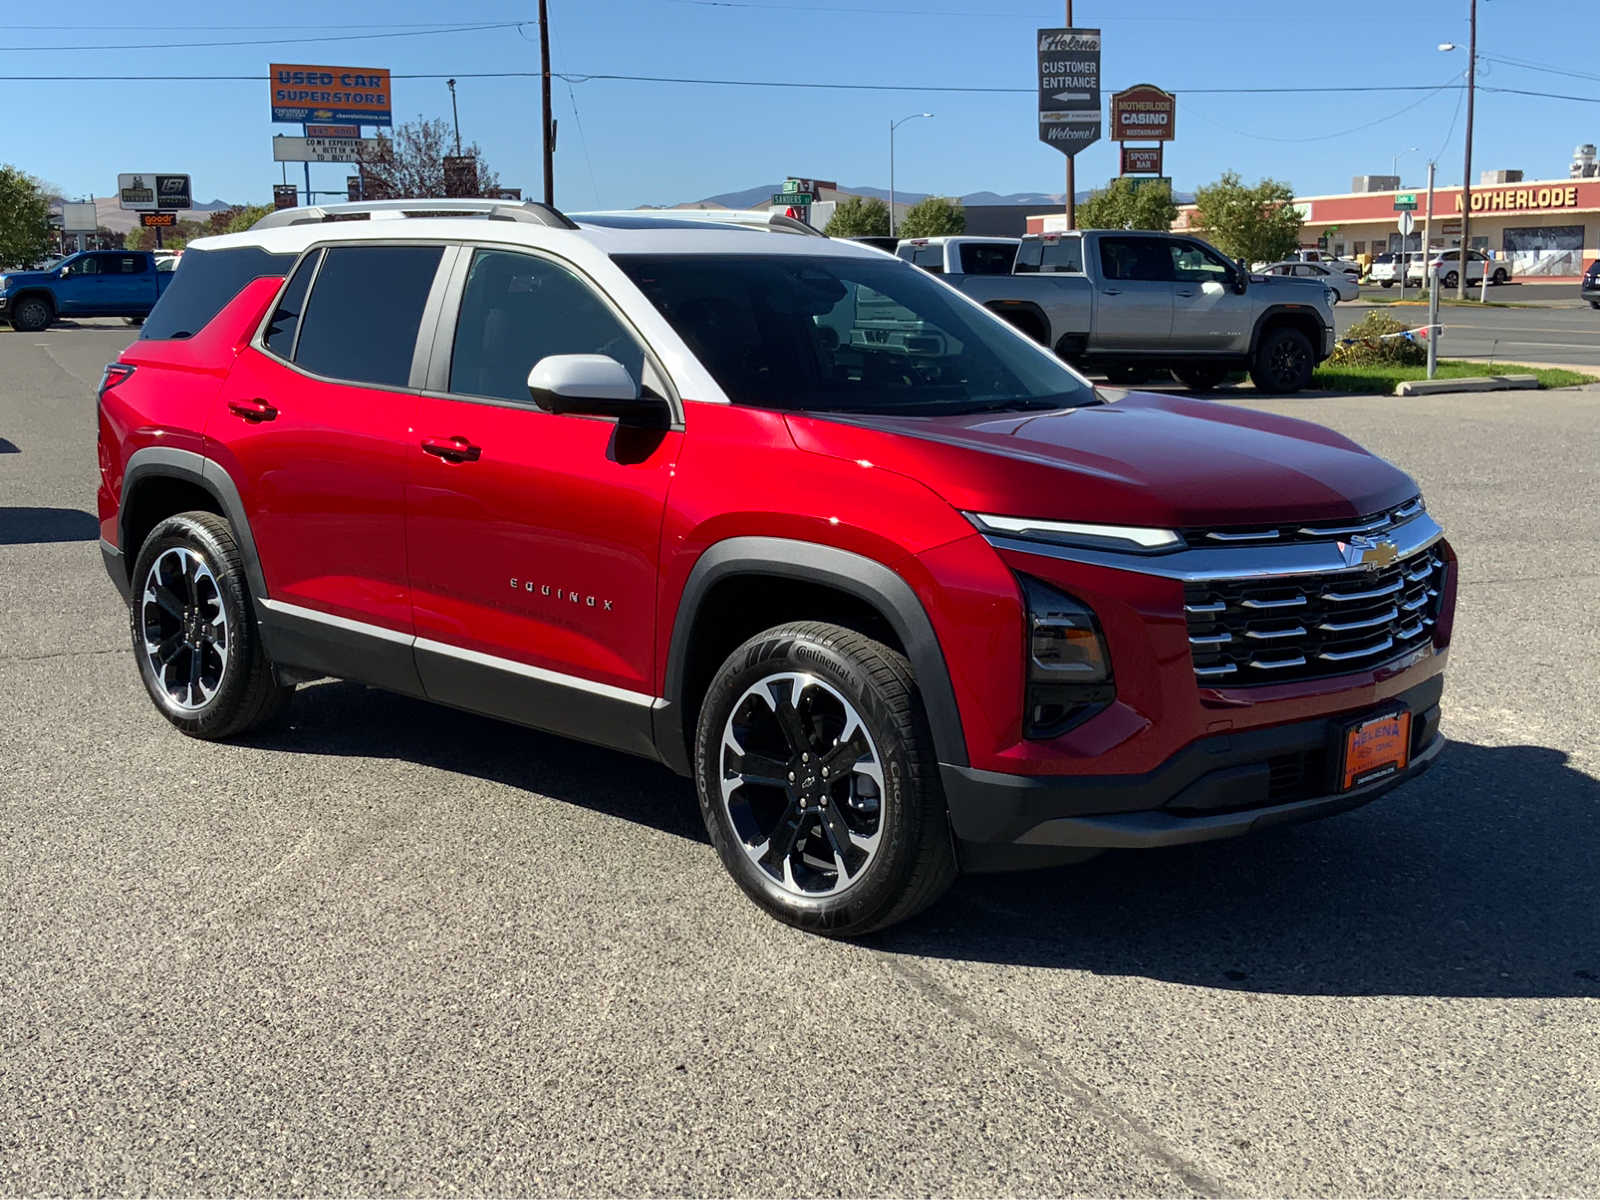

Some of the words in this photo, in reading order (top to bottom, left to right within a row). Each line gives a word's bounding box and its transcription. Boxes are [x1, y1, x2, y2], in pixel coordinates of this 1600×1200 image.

[1044, 33, 1099, 50] Helena
[1042, 62, 1097, 73] CUSTOMER
[278, 71, 334, 86] USED
[341, 74, 382, 88] CAR
[1043, 77, 1097, 88] ENTRANCE
[276, 90, 386, 105] SUPERSTORE
[1120, 102, 1171, 112] MOTHERLODE
[1121, 113, 1168, 125] CASINO
[1048, 126, 1096, 141] Welcome!
[1136, 161, 1151, 169] BAR
[510, 577, 613, 611] EQUINOX
[797, 645, 850, 682] Continental
